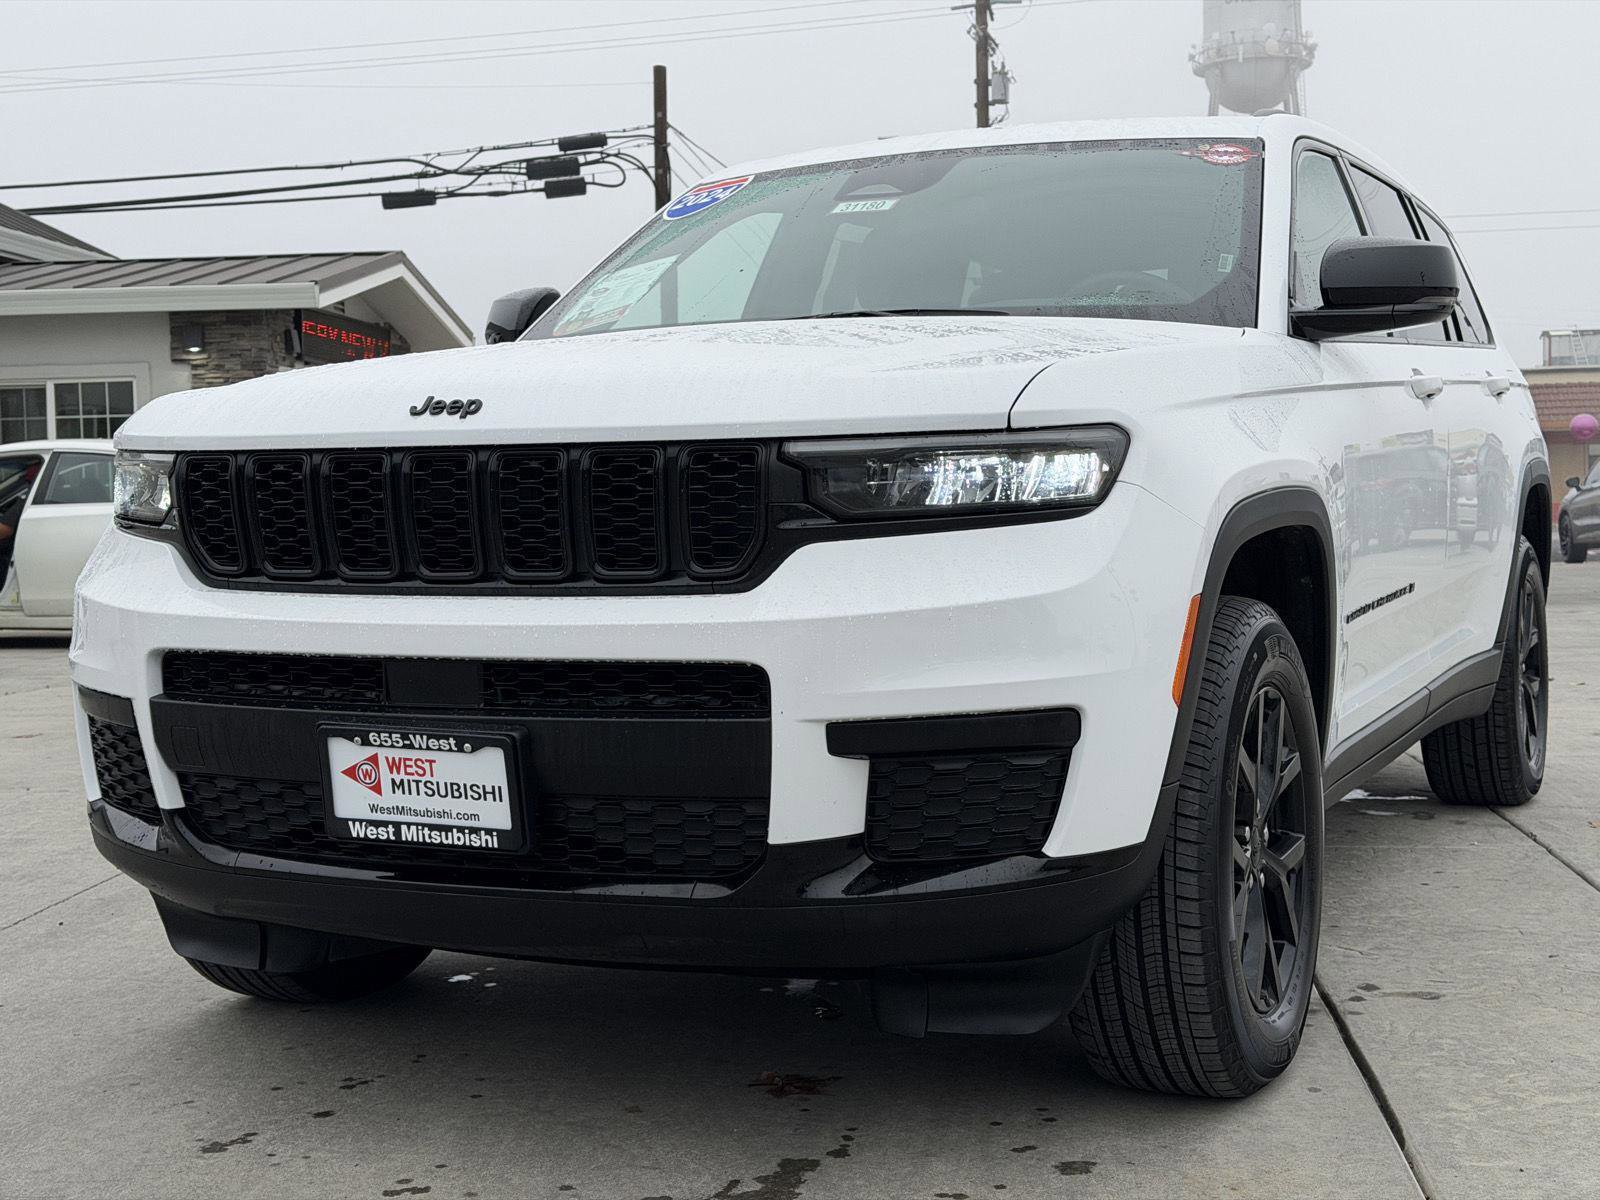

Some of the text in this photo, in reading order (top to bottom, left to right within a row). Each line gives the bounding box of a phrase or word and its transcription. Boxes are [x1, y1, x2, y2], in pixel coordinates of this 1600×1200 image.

[669, 185, 739, 210] 2024
[409, 395, 484, 420] Jeep
[368, 732, 458, 751] 655-West
[384, 755, 437, 778] WEST
[390, 777, 504, 803] MITSUBISHI
[367, 803, 481, 822] WestMitsubishi.com
[347, 820, 499, 849] West Mitsubishi
